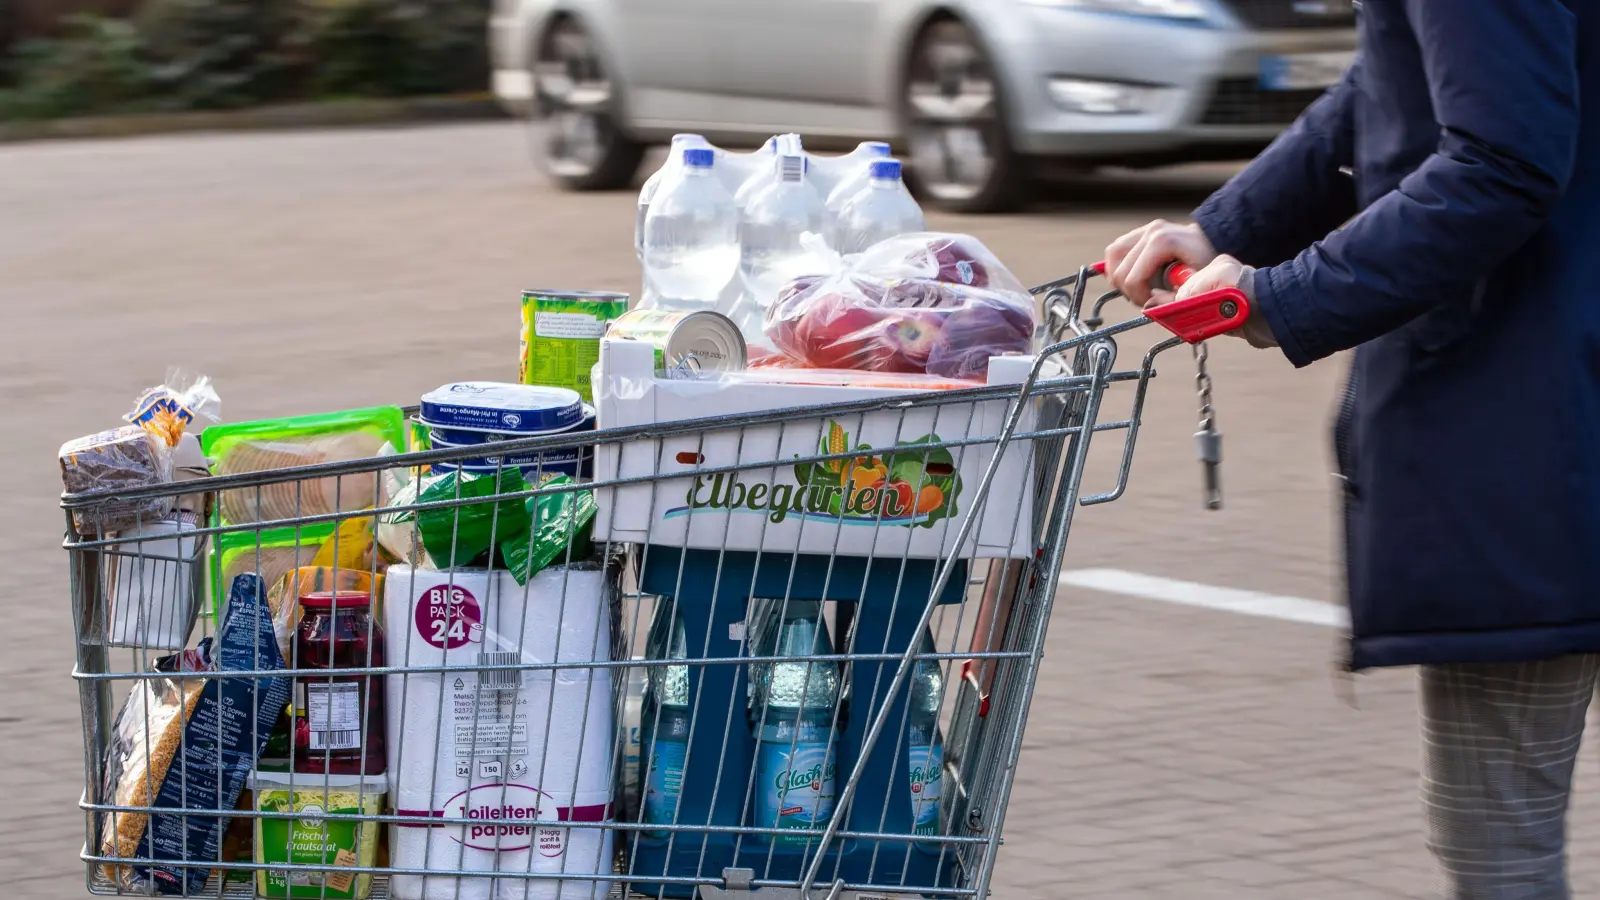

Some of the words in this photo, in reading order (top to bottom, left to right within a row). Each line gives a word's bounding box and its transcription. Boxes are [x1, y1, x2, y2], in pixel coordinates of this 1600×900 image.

[687, 472, 906, 523] Elbegarten
[430, 589, 464, 605] BIG
[430, 605, 465, 618] PACK
[431, 619, 466, 642] 24
[459, 805, 543, 820] Toiletten-
[285, 841, 337, 852] rautsaat
[275, 877, 286, 888] kg
